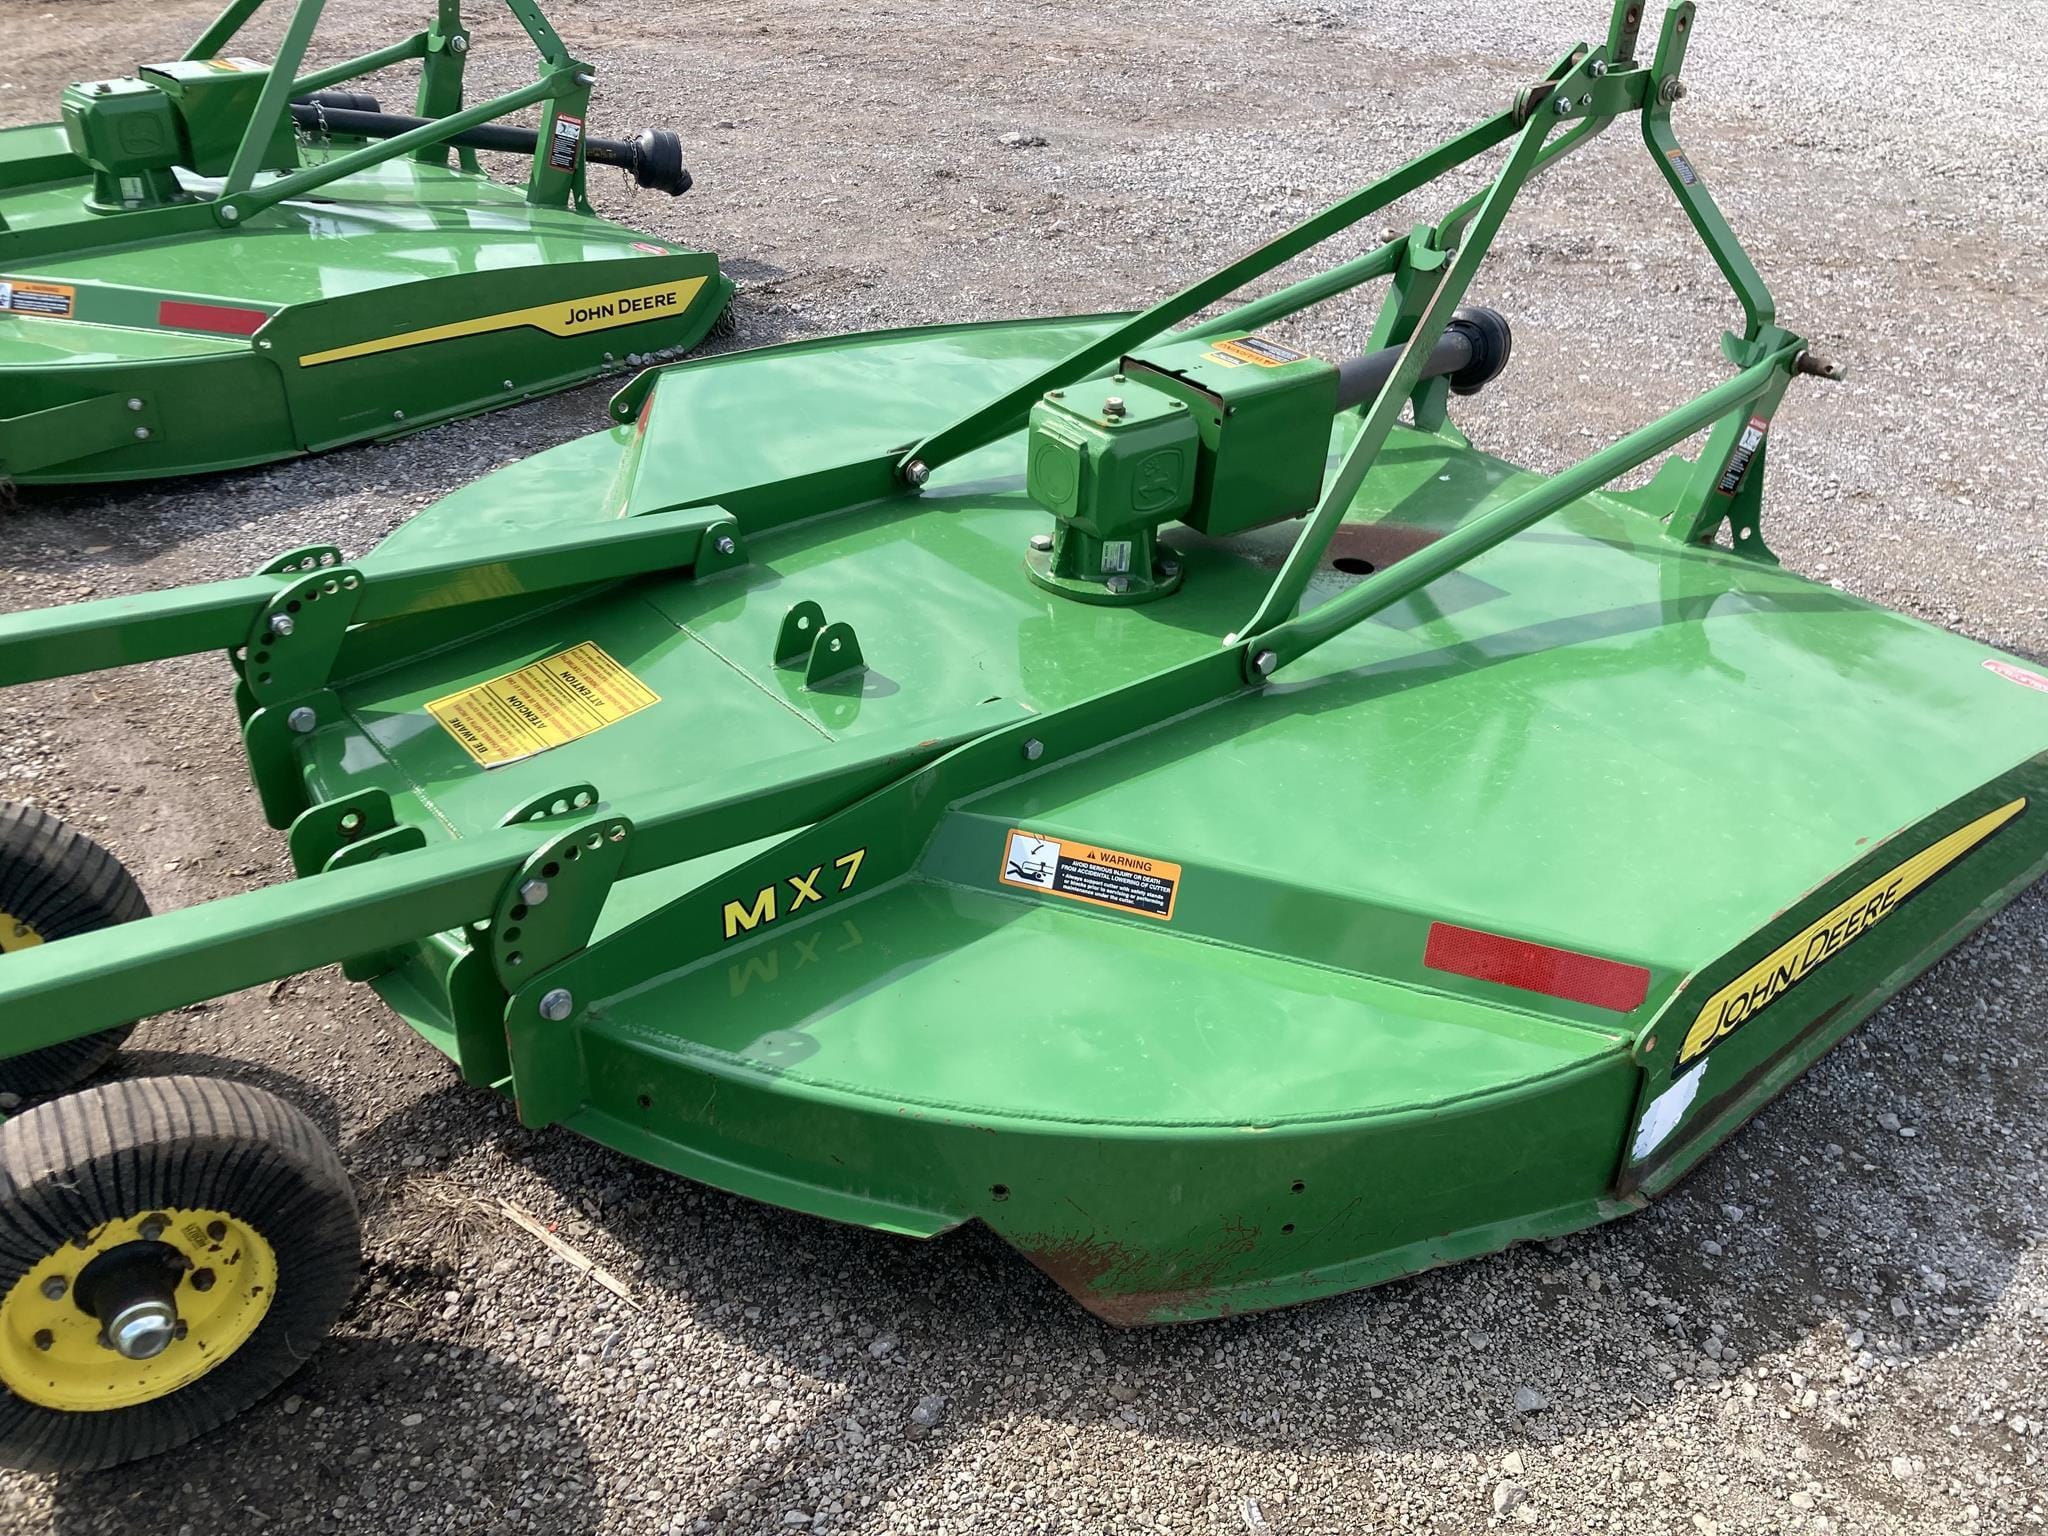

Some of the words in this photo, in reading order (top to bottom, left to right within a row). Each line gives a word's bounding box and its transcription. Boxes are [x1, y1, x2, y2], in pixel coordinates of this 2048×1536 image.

[565, 304, 614, 325] JOHN
[618, 292, 677, 314] DEERE
[558, 670, 605, 707] ATTENTION
[447, 717, 478, 743] AWARE
[471, 741, 489, 753] BE
[1089, 864, 1112, 874] SERIOUS
[1113, 869, 1133, 878] INJURY
[1142, 876, 1161, 884] DEATH
[1100, 852, 1152, 871] WARNING
[1060, 864, 1077, 872] FROM
[1077, 868, 1111, 880] ACCIDENTAL
[1111, 876, 1140, 886] LOWERING
[1149, 883, 1171, 893] CUTTER
[1700, 955, 1799, 1048] JOHN
[1802, 878, 1903, 968] DEERE
